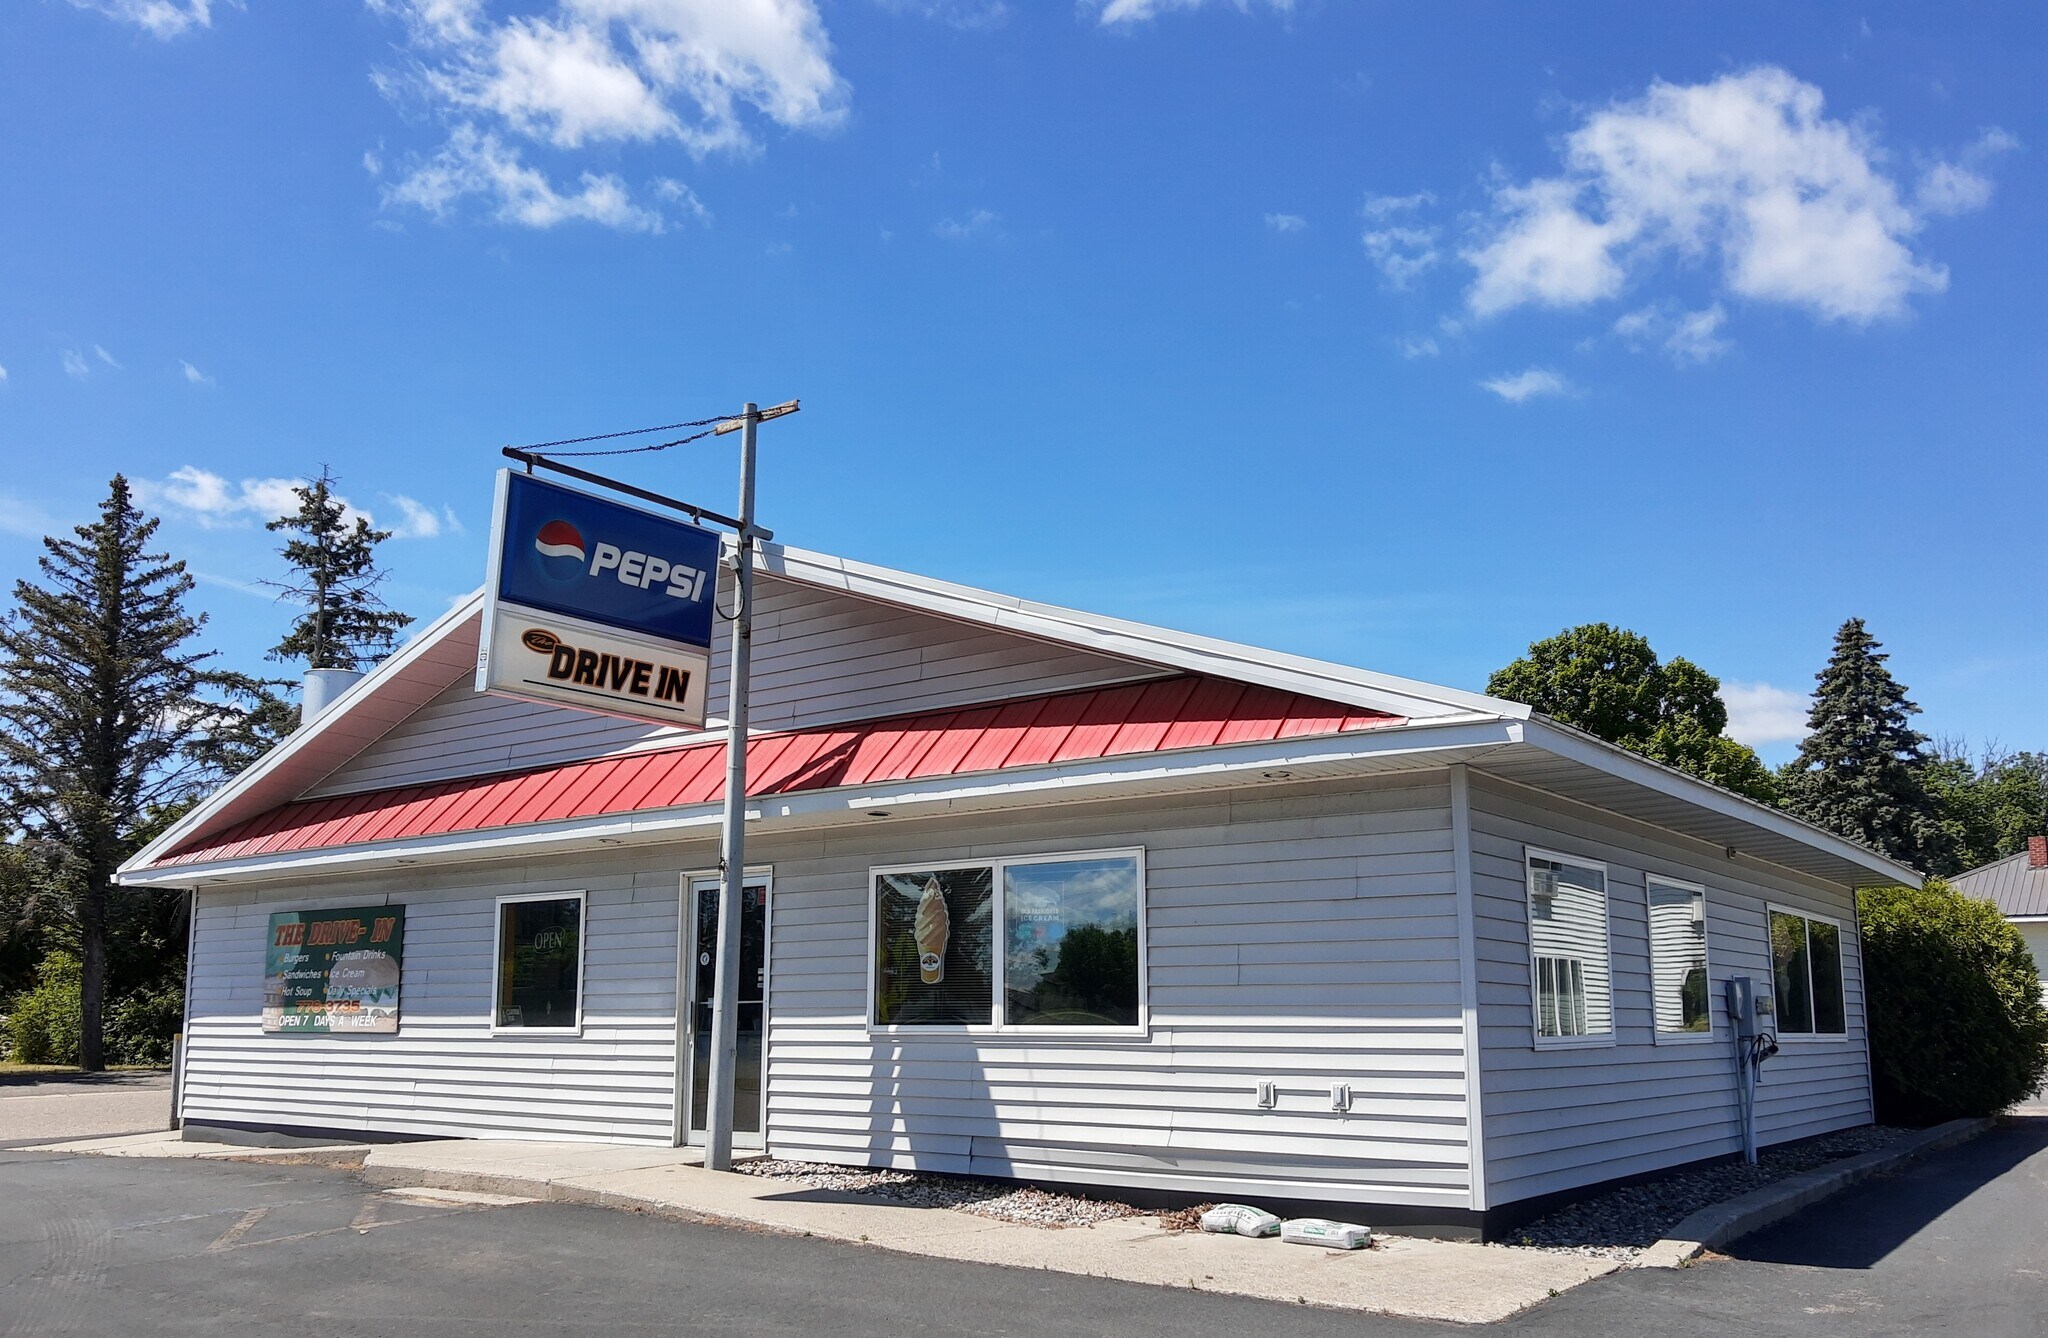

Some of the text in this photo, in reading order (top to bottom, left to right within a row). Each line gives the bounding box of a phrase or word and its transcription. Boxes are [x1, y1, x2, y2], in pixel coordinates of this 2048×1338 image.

[589, 542, 706, 603] PEPSI
[547, 644, 691, 704] DRIVE IN
[274, 923, 305, 946] THE
[370, 917, 395, 942] IN
[534, 931, 562, 950] OPEN
[284, 953, 309, 964] Burgers
[331, 949, 386, 961] Fountain Drinks
[283, 969, 322, 980] Sandwiches
[329, 968, 365, 978] Ice Cream
[281, 986, 312, 997] Hot Soup
[328, 984, 377, 996] Daily Specials
[278, 1014, 378, 1027] OPEN 7 DAYS A WEEK
